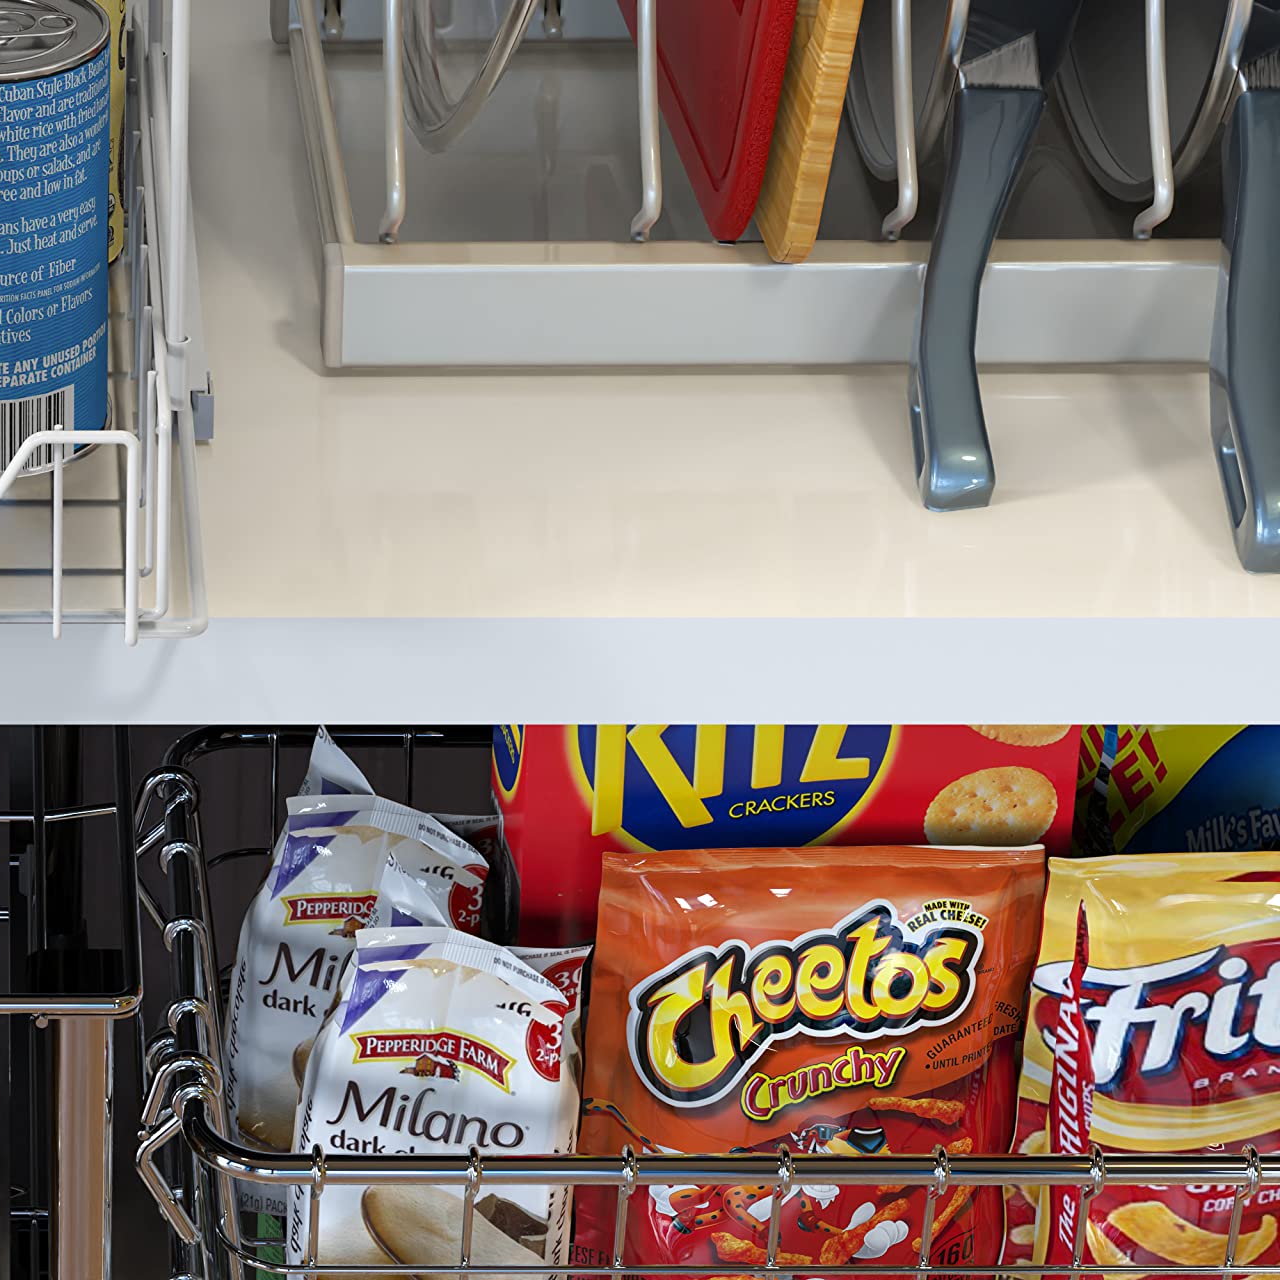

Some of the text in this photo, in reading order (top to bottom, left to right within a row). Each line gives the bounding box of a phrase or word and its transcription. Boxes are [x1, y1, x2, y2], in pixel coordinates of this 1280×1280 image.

[36, 78, 63, 100] Style
[64, 68, 87, 90] Black
[32, 122, 54, 139] rice
[55, 114, 77, 132] with
[77, 101, 96, 125] fried
[35, 99, 56, 118] and
[57, 96, 75, 112] are
[6, 131, 84, 165] They are also a
[26, 165, 40, 179] or
[42, 154, 76, 177] salads,
[76, 144, 91, 165] and
[19, 182, 42, 200] and
[44, 179, 62, 197] low
[63, 174, 73, 190] in
[74, 167, 88, 186] fat.
[21, 216, 48, 234] have
[49, 214, 56, 227] a
[57, 207, 79, 225] very
[79, 196, 97, 217] easy
[6, 238, 32, 255] Just
[34, 234, 57, 251] heat
[58, 228, 77, 248] and
[30, 264, 44, 282] of
[48, 258, 77, 280] Fiber
[6, 287, 94, 325] Colors or Flavors
[20, 291, 36, 301] FACTS
[37, 288, 52, 298] PANEL
[53, 284, 63, 294] FOR
[14, 358, 39, 373] ANY
[42, 344, 80, 368] UNUSED
[50, 346, 97, 379] CONTAINER
[729, 790, 836, 819] CRACKERS
[906, 912, 938, 933] REAL
[924, 901, 947, 912] MADE
[262, 989, 317, 1018] dark
[647, 915, 970, 1091] Cheetos
[366, 1037, 499, 1075] PEPPERIDGE FARM
[932, 1023, 1017, 1070] UNTIL DATE
[741, 1046, 907, 1121] Crunchy
[326, 1080, 525, 1148] Milano
[329, 1129, 386, 1154] dark
[1058, 1194, 1076, 1251] The
[937, 1233, 975, 1265] 160
